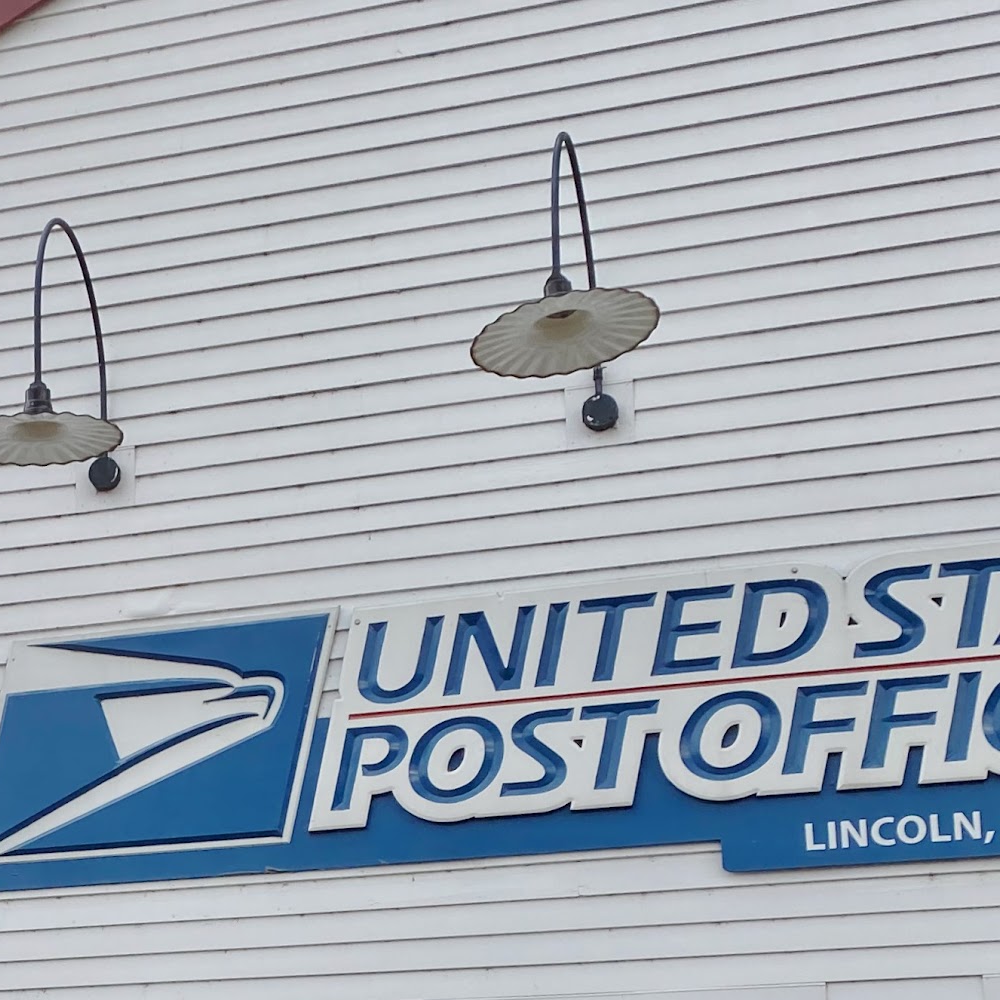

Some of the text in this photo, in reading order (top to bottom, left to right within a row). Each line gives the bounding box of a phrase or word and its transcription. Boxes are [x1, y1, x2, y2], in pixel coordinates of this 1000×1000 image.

[357, 557, 1000, 704] UNITED ST
[330, 670, 1000, 812] POST OFFI
[803, 810, 996, 851] LINCOLN,
